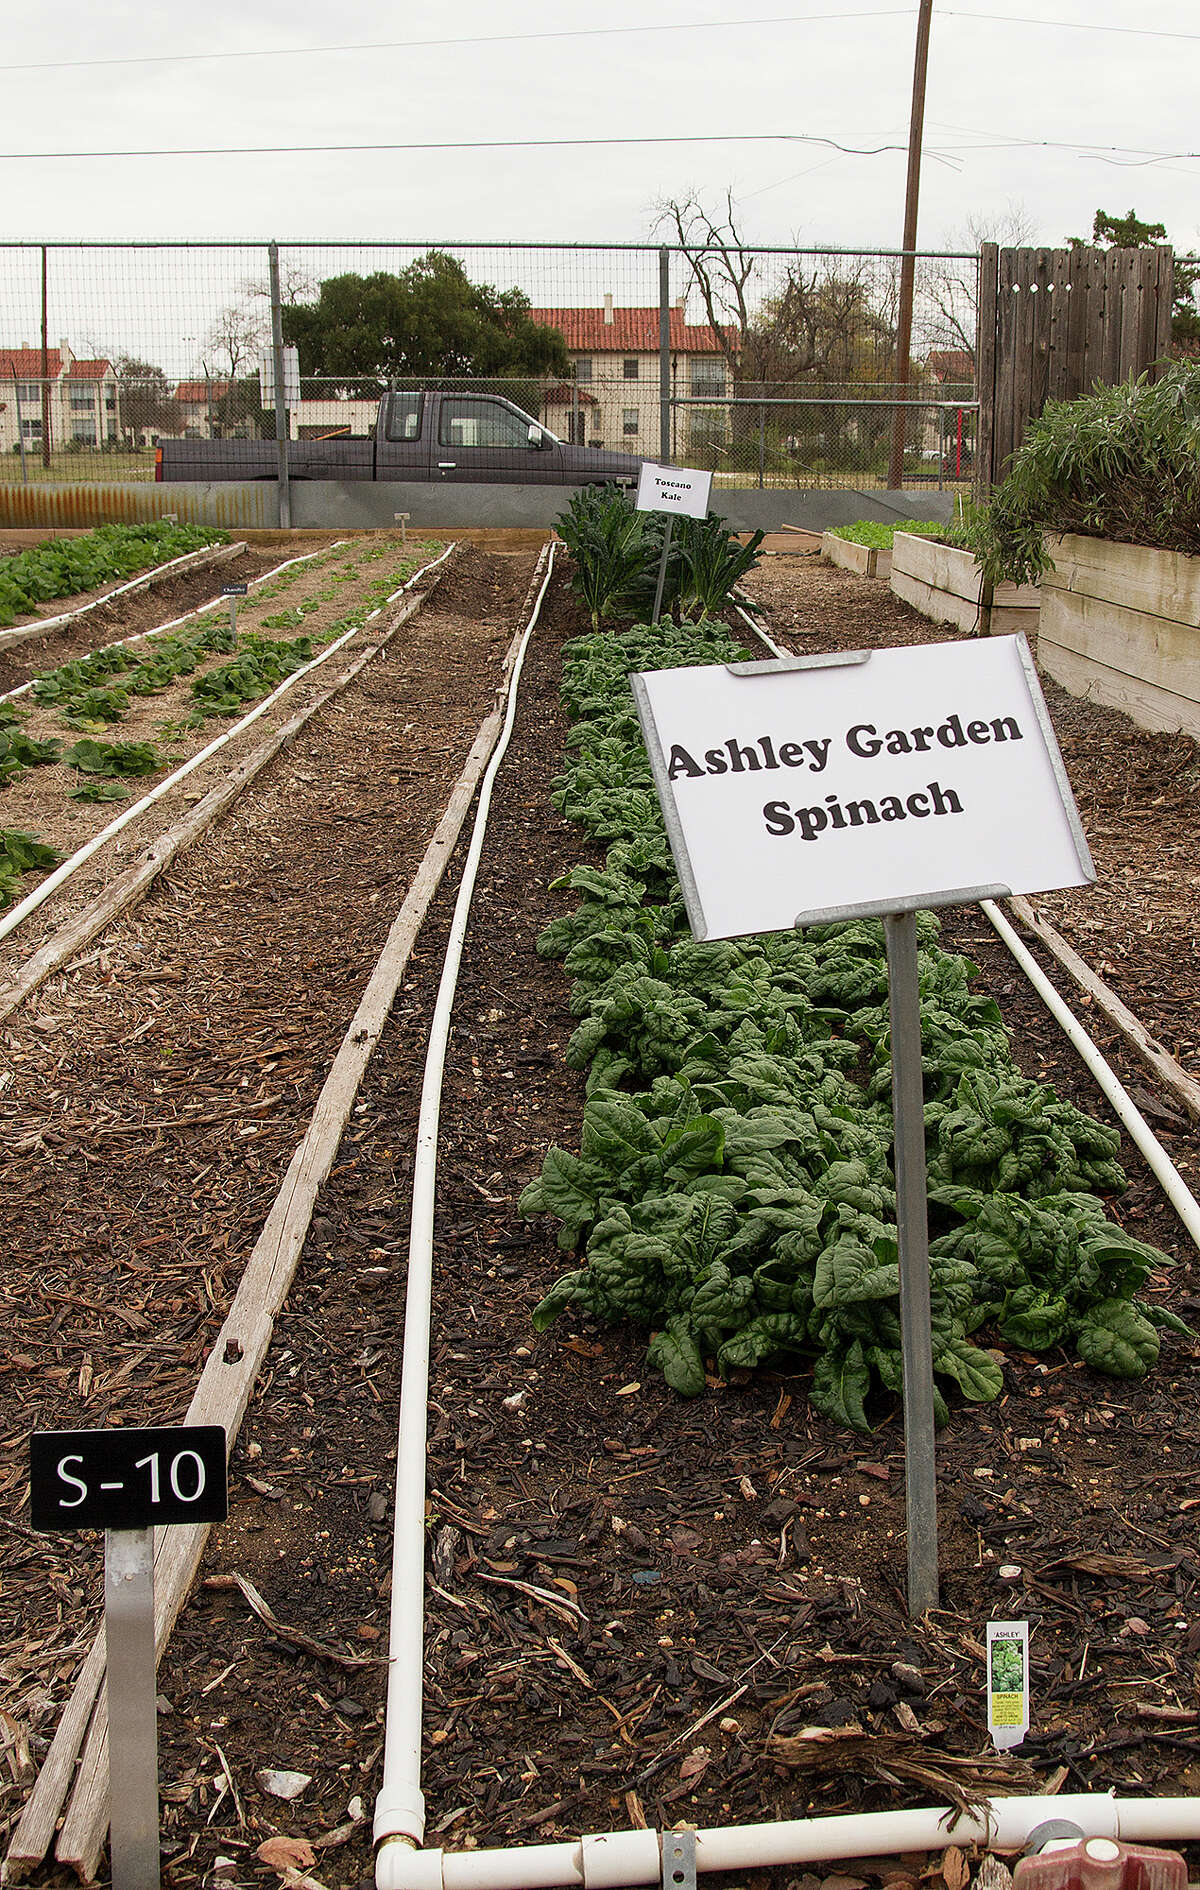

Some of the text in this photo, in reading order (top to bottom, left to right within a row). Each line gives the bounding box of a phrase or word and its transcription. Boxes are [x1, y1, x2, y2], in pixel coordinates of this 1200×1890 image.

[655, 478, 692, 489] Toscano
[661, 491, 682, 501] Kale
[666, 713, 1024, 781] Ashley Garden
[762, 781, 965, 842] Spinach
